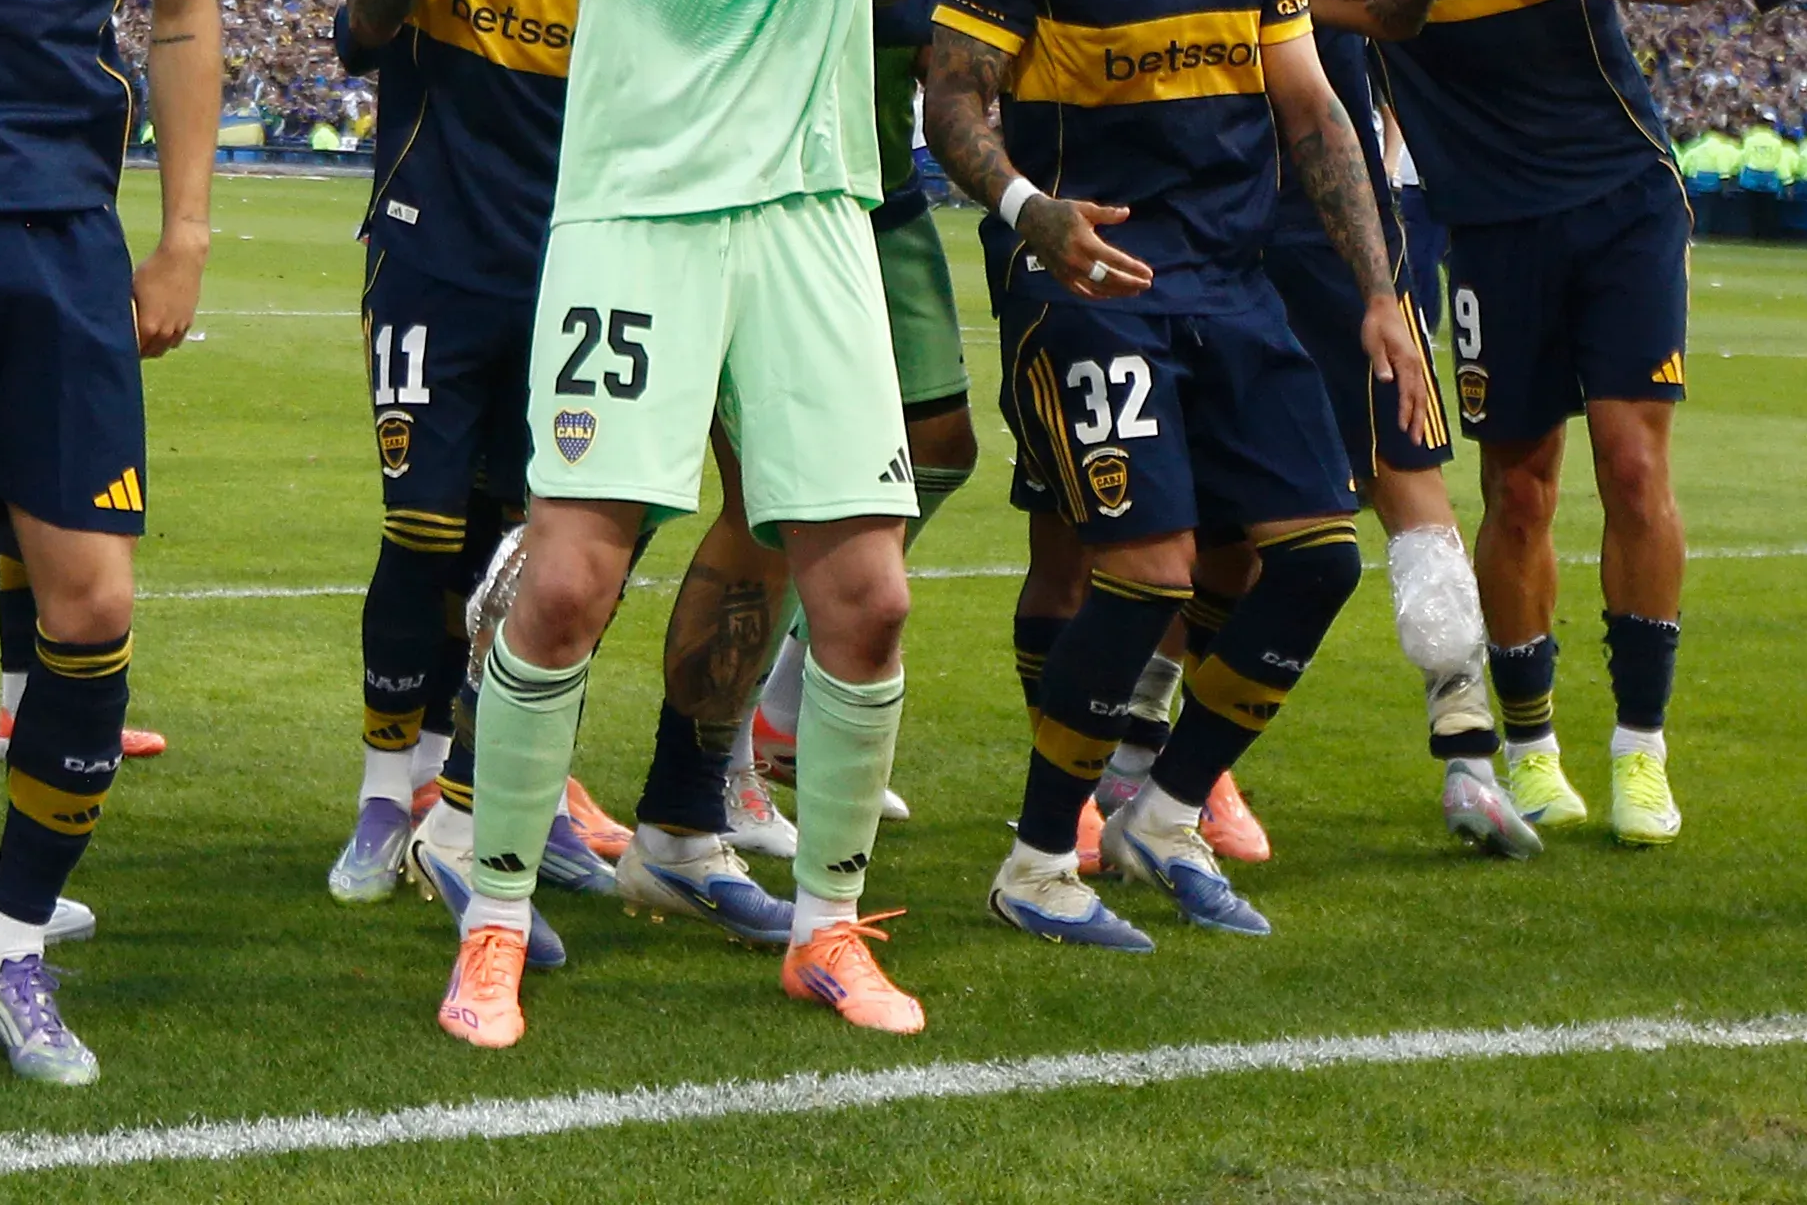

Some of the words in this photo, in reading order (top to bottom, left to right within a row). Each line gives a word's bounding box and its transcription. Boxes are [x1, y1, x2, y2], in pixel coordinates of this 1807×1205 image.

[555, 306, 654, 402] 25
[1455, 288, 1482, 360] 9
[375, 325, 431, 406] 11
[1067, 355, 1159, 445] 32
[556, 425, 593, 440] CABJ
[1095, 473, 1123, 491] CABJ
